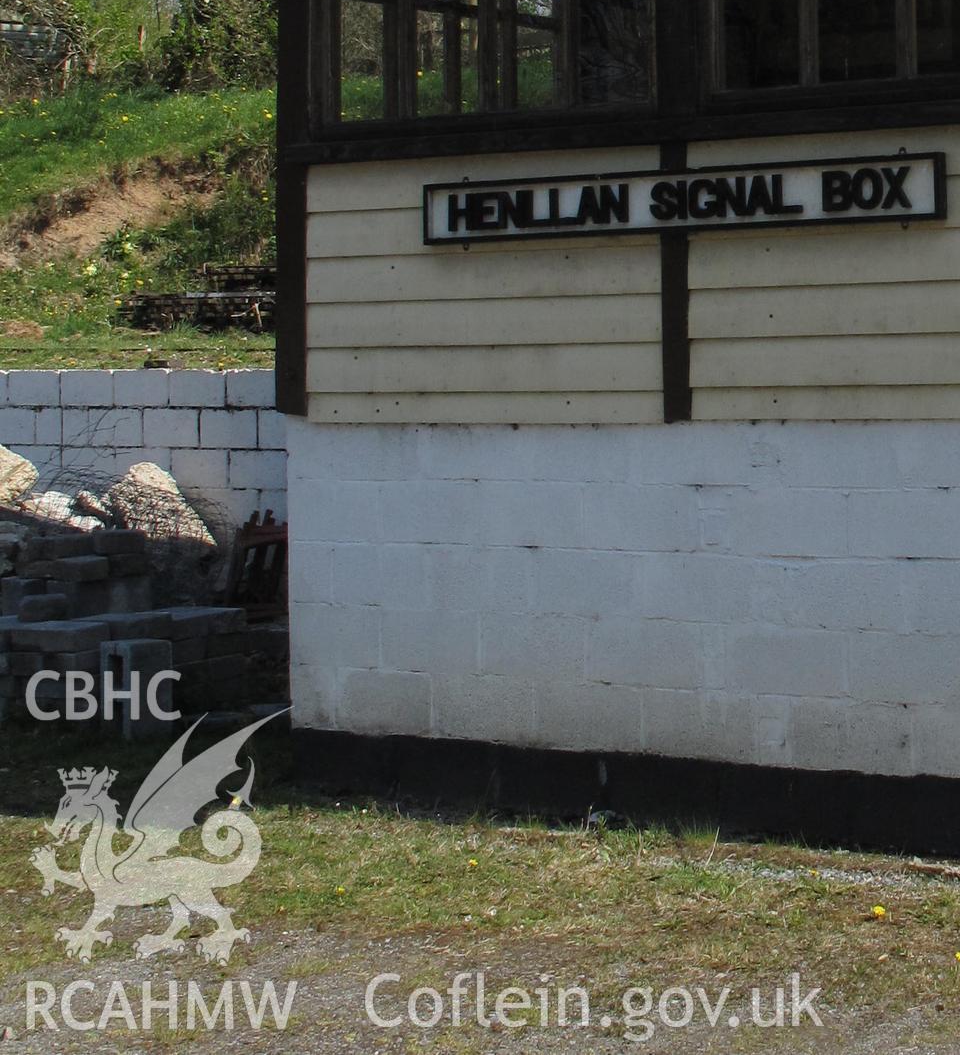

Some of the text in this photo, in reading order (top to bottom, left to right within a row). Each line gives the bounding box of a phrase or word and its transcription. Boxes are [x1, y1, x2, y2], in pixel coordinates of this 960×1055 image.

[447, 165, 913, 233] HENLLAN SIGNAL BOX
